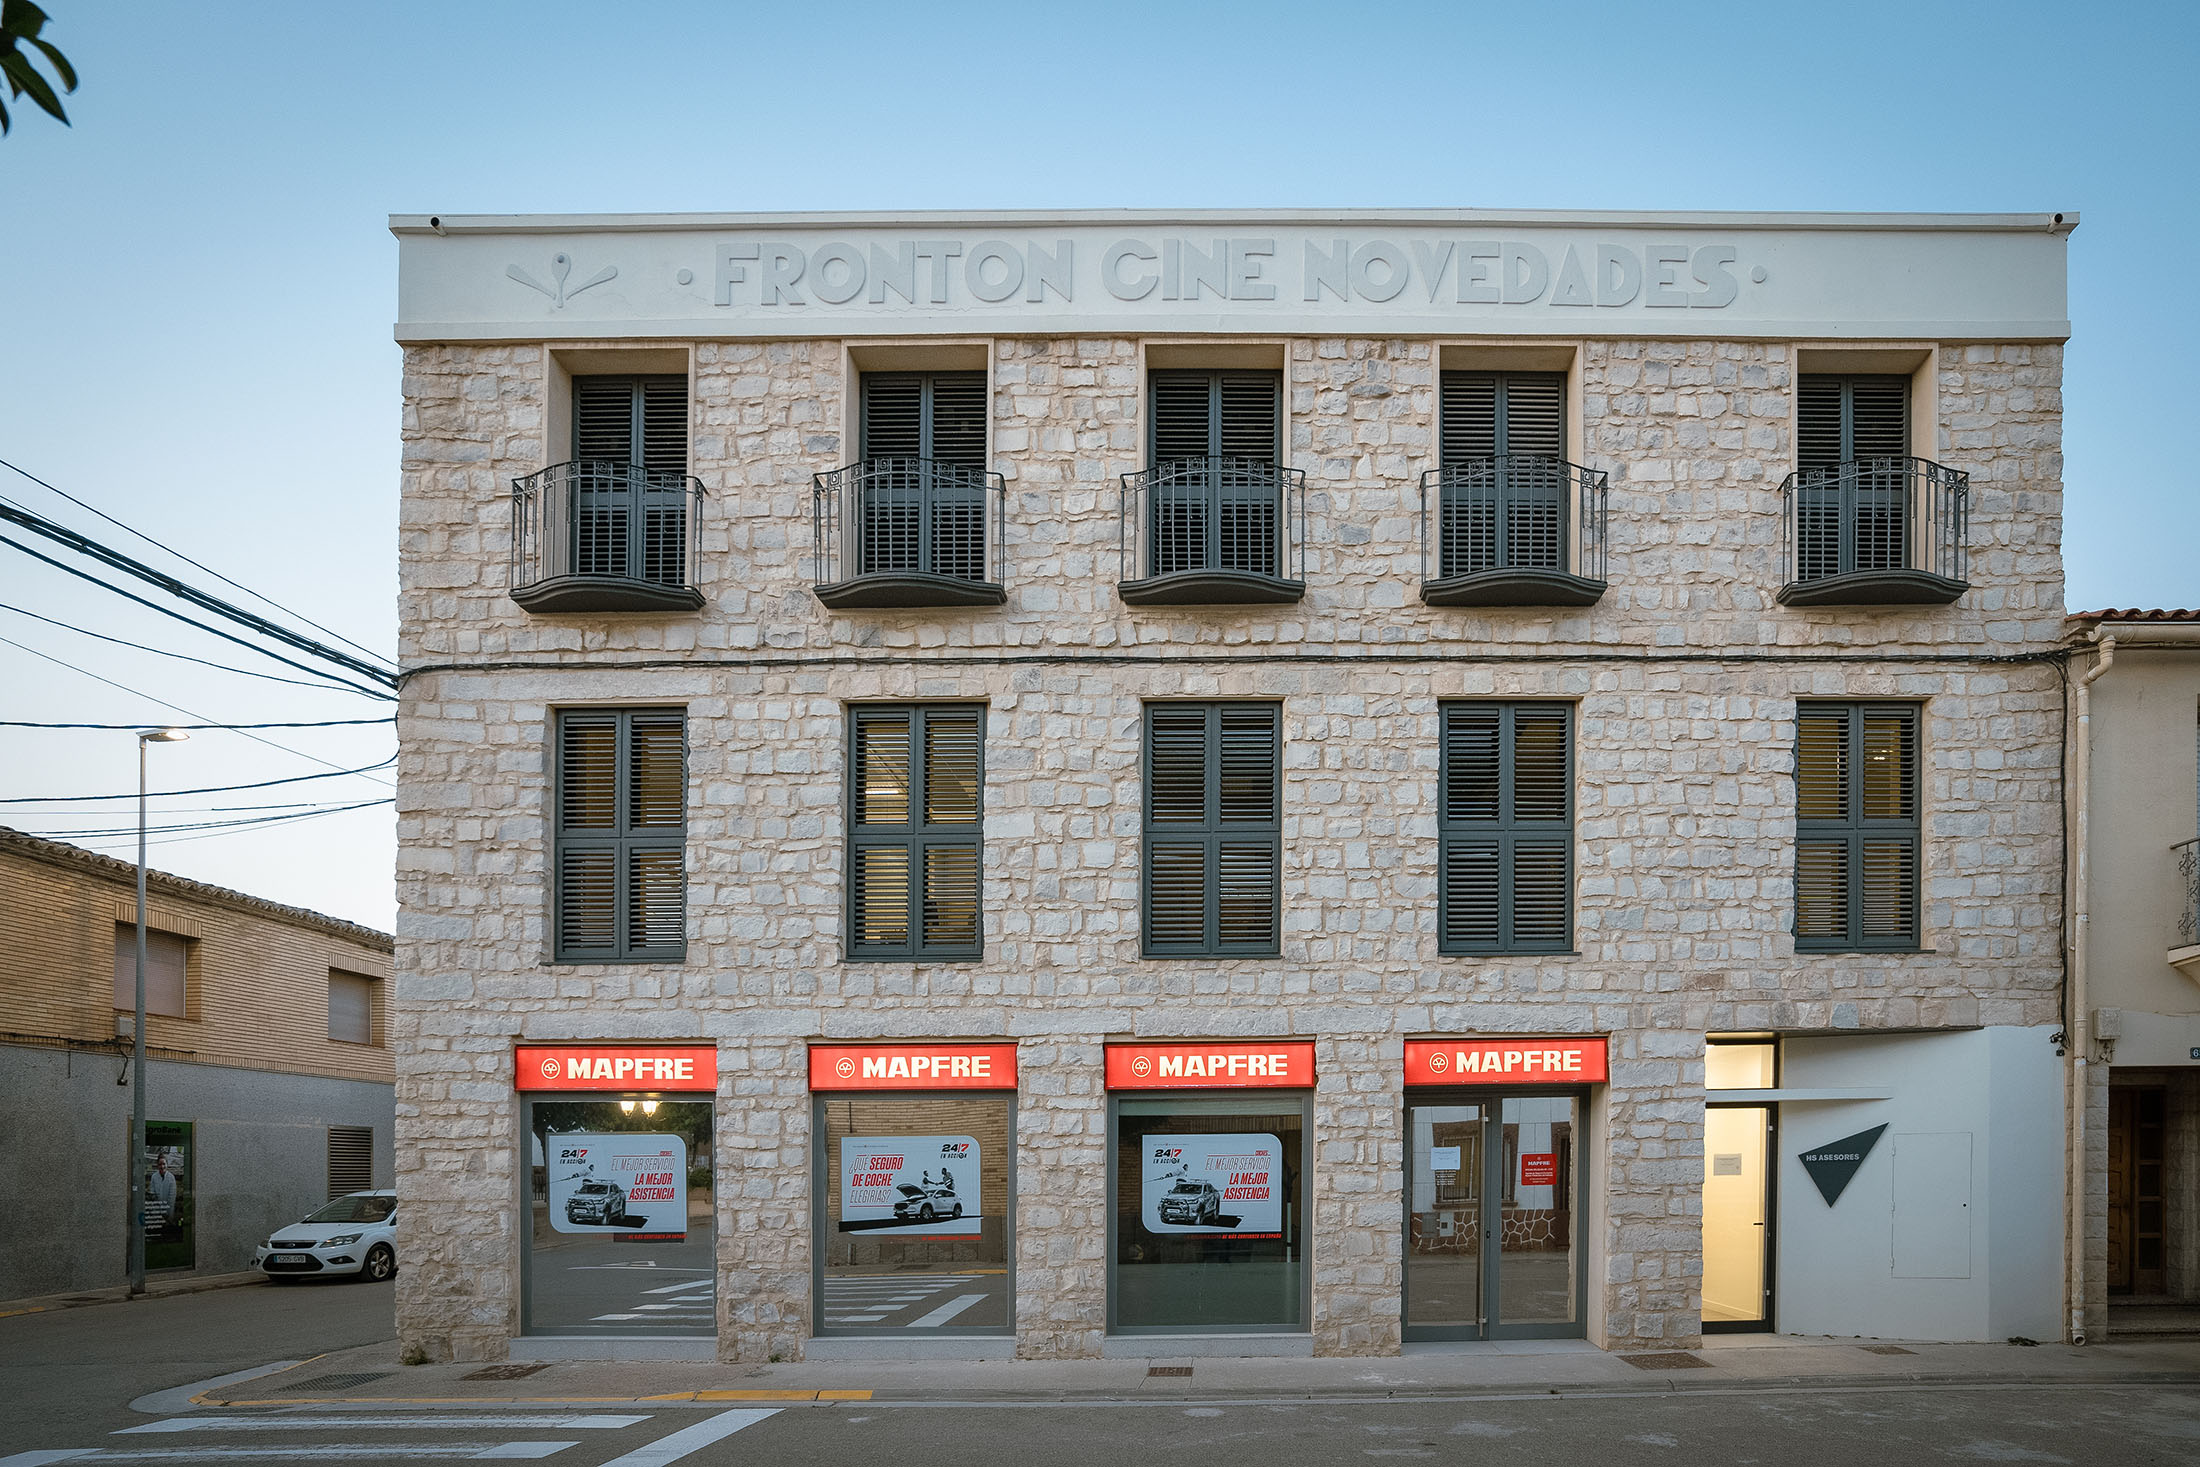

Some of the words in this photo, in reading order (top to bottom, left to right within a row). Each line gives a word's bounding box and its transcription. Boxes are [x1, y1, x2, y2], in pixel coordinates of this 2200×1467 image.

[714, 237, 1073, 307] FRONTON
[1101, 237, 1276, 303] CINE
[1303, 237, 1738, 309] NOVEDADES
[862, 1055, 991, 1078] MAPFRE
[1158, 1054, 1288, 1077] MAPFRE
[1456, 1050, 1582, 1073] MAPFRE
[567, 1057, 694, 1080] MAPFRE
[611, 1158, 620, 1171] EL
[621, 1158, 643, 1171] MEJOR
[644, 1157, 676, 1170] SERVICIO
[869, 1157, 904, 1170] SEGURO
[1205, 1158, 1213, 1170] EL
[1215, 1158, 1239, 1170] MEJOR
[1239, 1157, 1271, 1170] SERVICIO
[1806, 1154, 1818, 1162] HS
[1818, 1153, 1860, 1162] ASESORES
[634, 1173, 645, 1185] LA
[645, 1172, 673, 1185] MEJOR
[852, 1174, 864, 1187] DE
[864, 1173, 893, 1187] COCHE
[1229, 1172, 1239, 1185] LA
[1240, 1172, 1269, 1185] MEJOR
[628, 1187, 675, 1200] ASISTENCIA
[1223, 1187, 1270, 1200] ASISTENCIA
